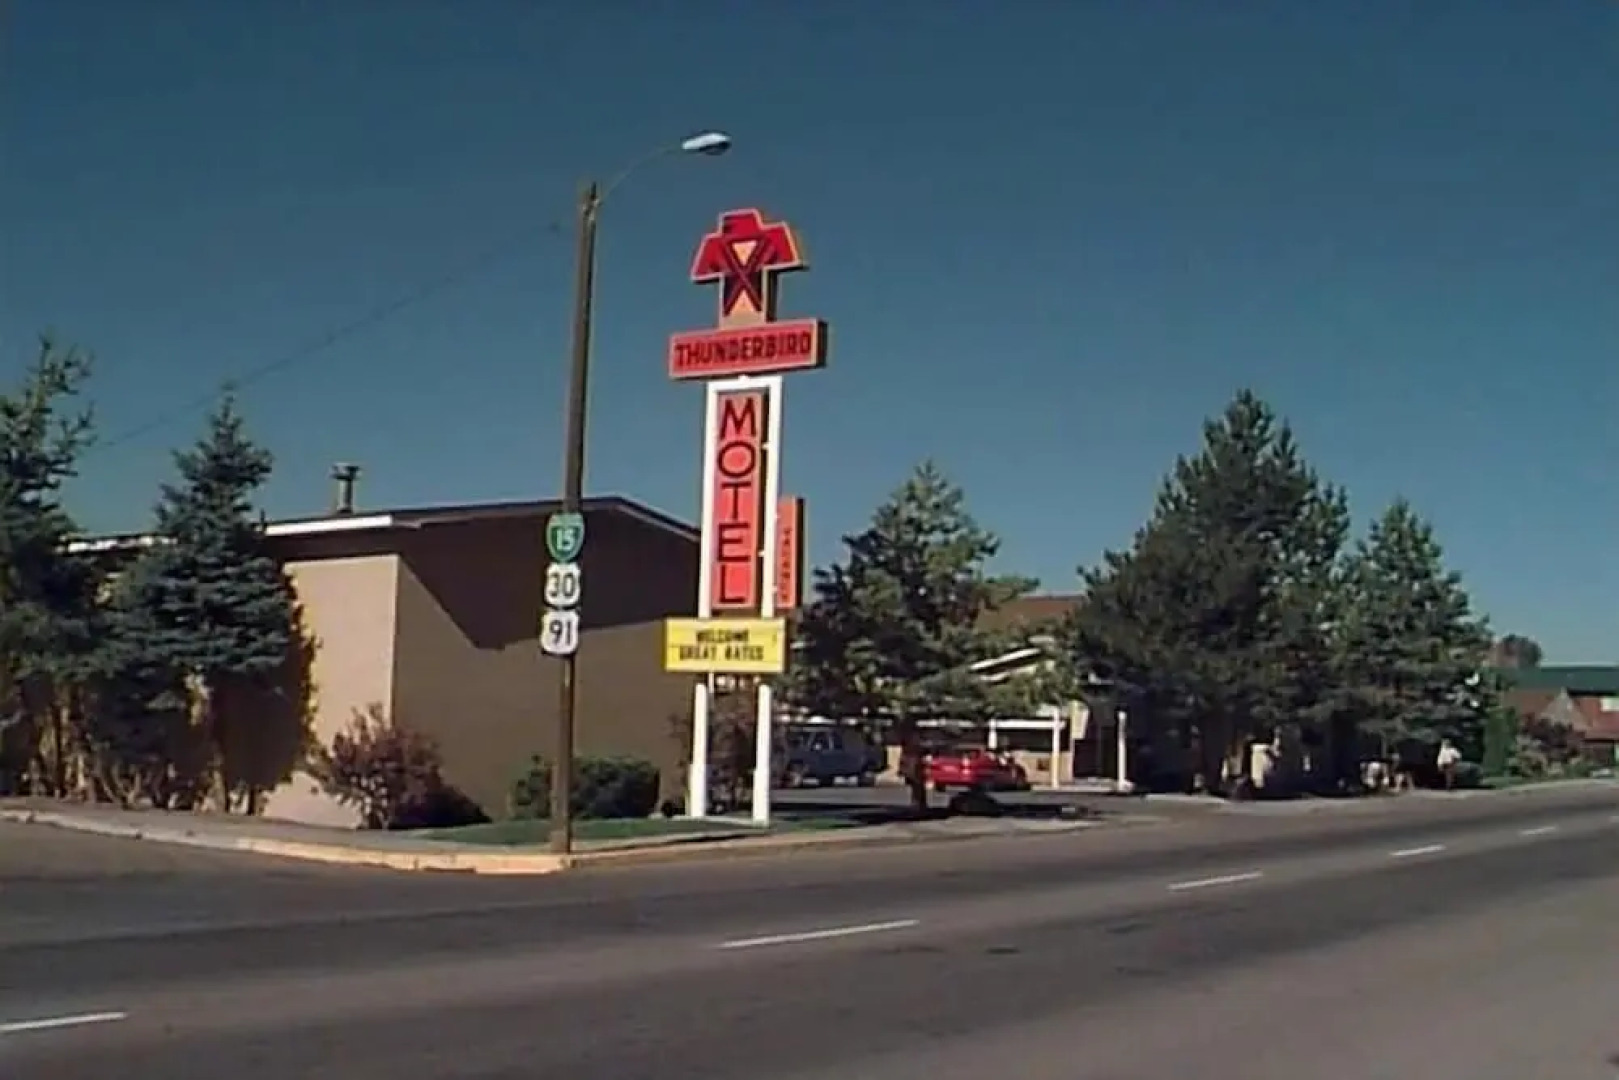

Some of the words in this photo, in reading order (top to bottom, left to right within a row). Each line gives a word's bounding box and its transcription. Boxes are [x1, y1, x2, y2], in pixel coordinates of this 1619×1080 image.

[674, 331, 811, 366] THUNDERBIRD
[717, 397, 757, 603] MOTEL
[556, 529, 574, 550] 15
[550, 573, 575, 598] 30
[551, 620, 572, 646] 91
[680, 646, 717, 660] GREAT
